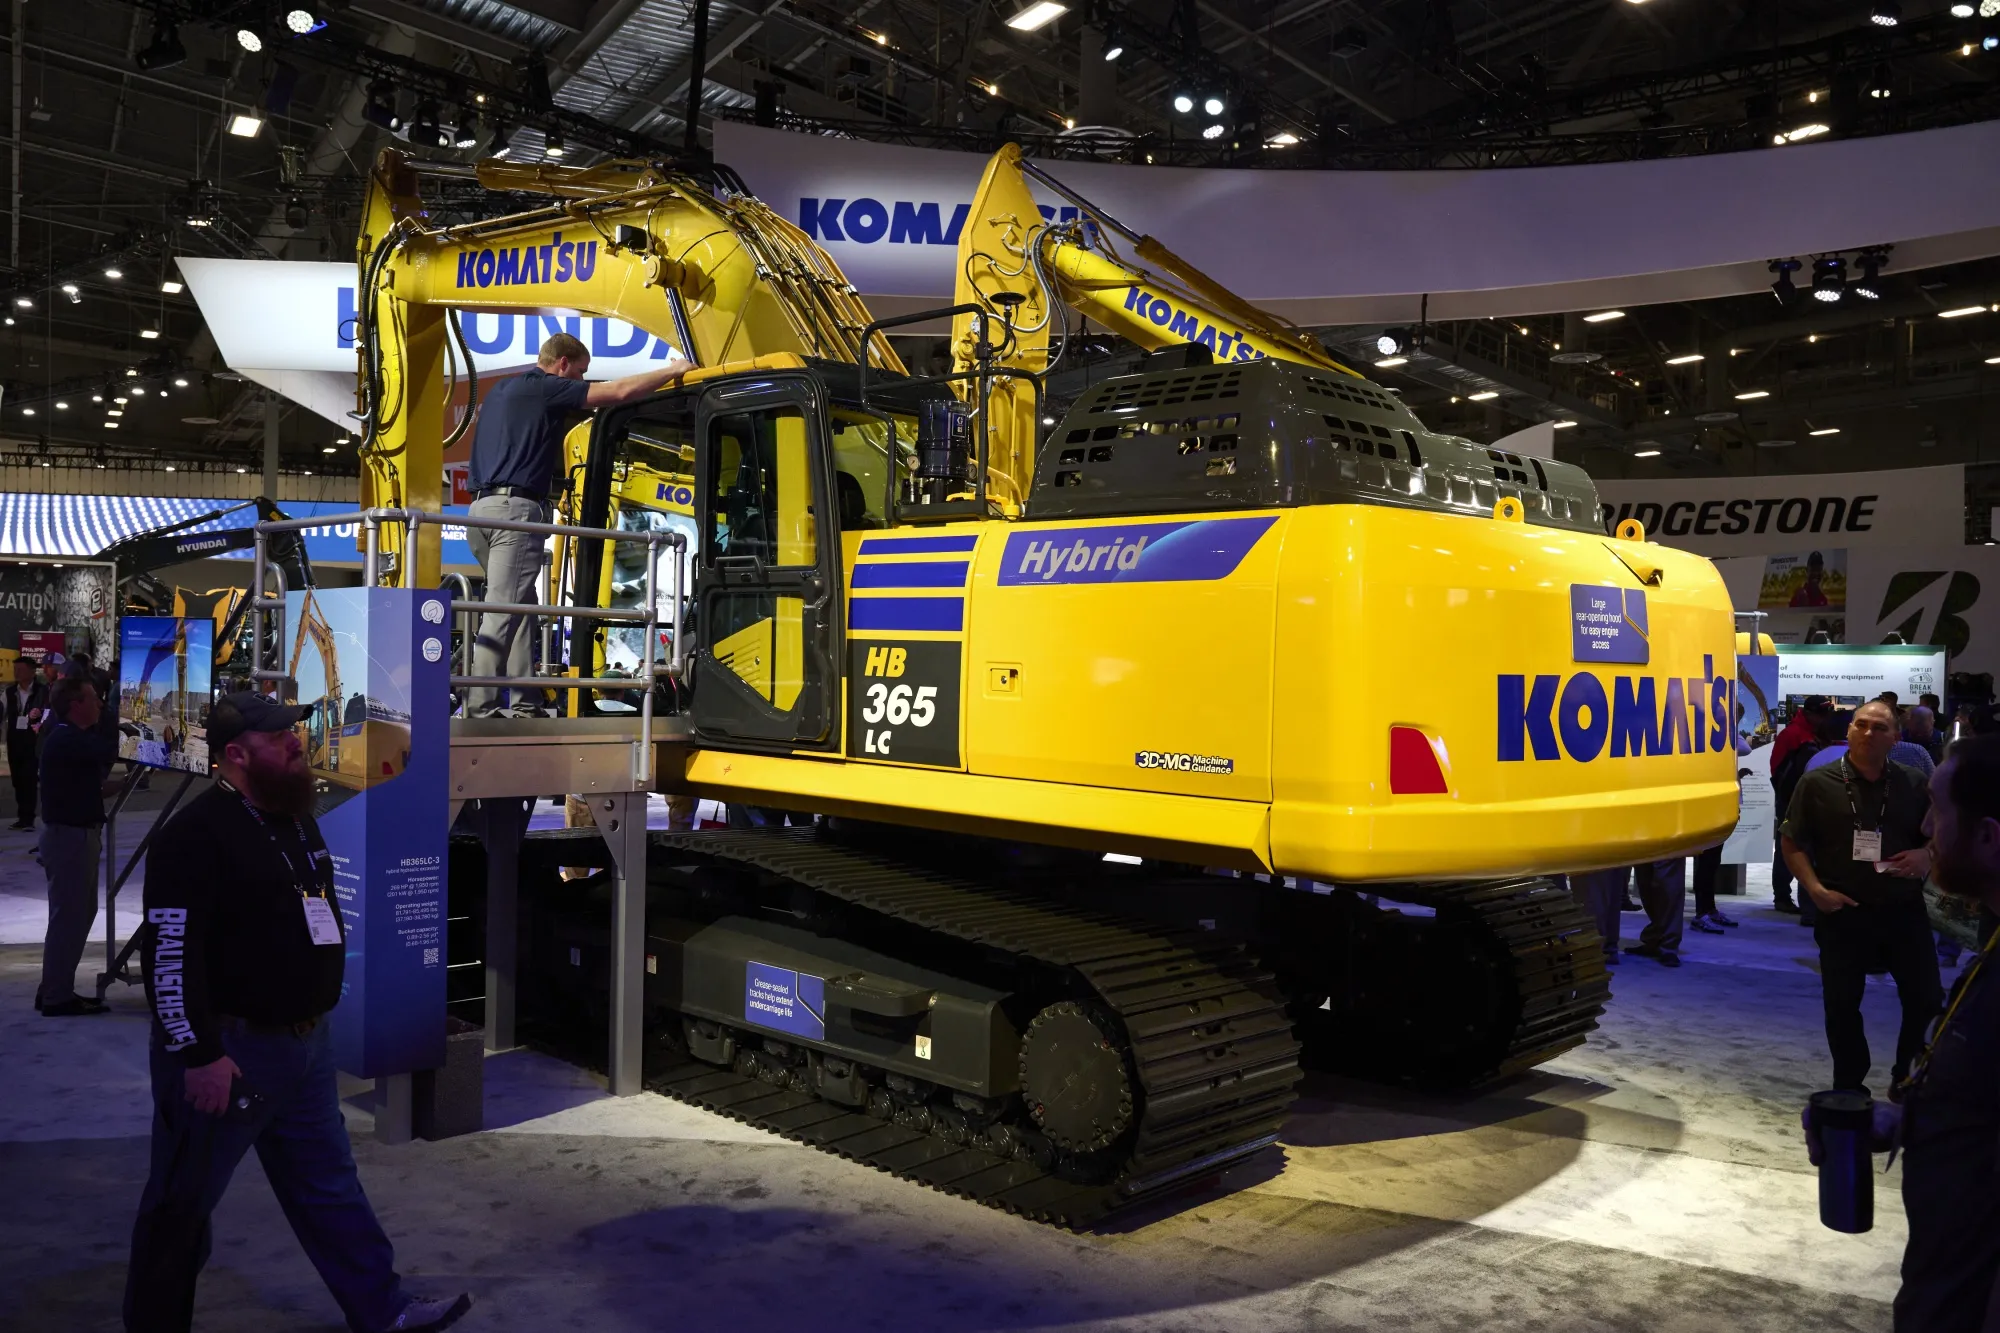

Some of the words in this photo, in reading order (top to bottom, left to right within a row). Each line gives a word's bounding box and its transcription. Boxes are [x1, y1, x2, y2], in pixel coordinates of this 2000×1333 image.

[456, 231, 597, 289] KOMATSU
[1124, 284, 1271, 363] KOMATS
[1600, 495, 1878, 537] RIDGESTONE
[177, 538, 228, 554] HYUNDAI
[1018, 535, 1149, 580] Hybrid
[1591, 598, 1606, 611] Large
[1575, 612, 1609, 625] rear-opening
[1609, 612, 1622, 623] hood
[1580, 624, 1588, 635] for
[1588, 627, 1601, 638] easy
[1601, 626, 1619, 638] engine
[1591, 640, 1610, 650] access
[864, 647, 908, 678] HB
[1815, 673, 1839, 681] heavy
[1909, 683, 1932, 691] BREAK
[862, 683, 938, 728] 365
[865, 730, 892, 755] LC
[1138, 751, 1191, 771] 3D-MG
[1192, 754, 1229, 766] Machine
[1191, 763, 1232, 775] Guidance
[400, 856, 440, 867] HB365LC-3
[754, 978, 789, 994] Grease-sealed
[749, 988, 765, 1000] tracks
[765, 991, 776, 1003] help
[776, 996, 793, 1006] extend
[749, 1000, 784, 1016] undercarriage
[784, 1007, 793, 1017] life
